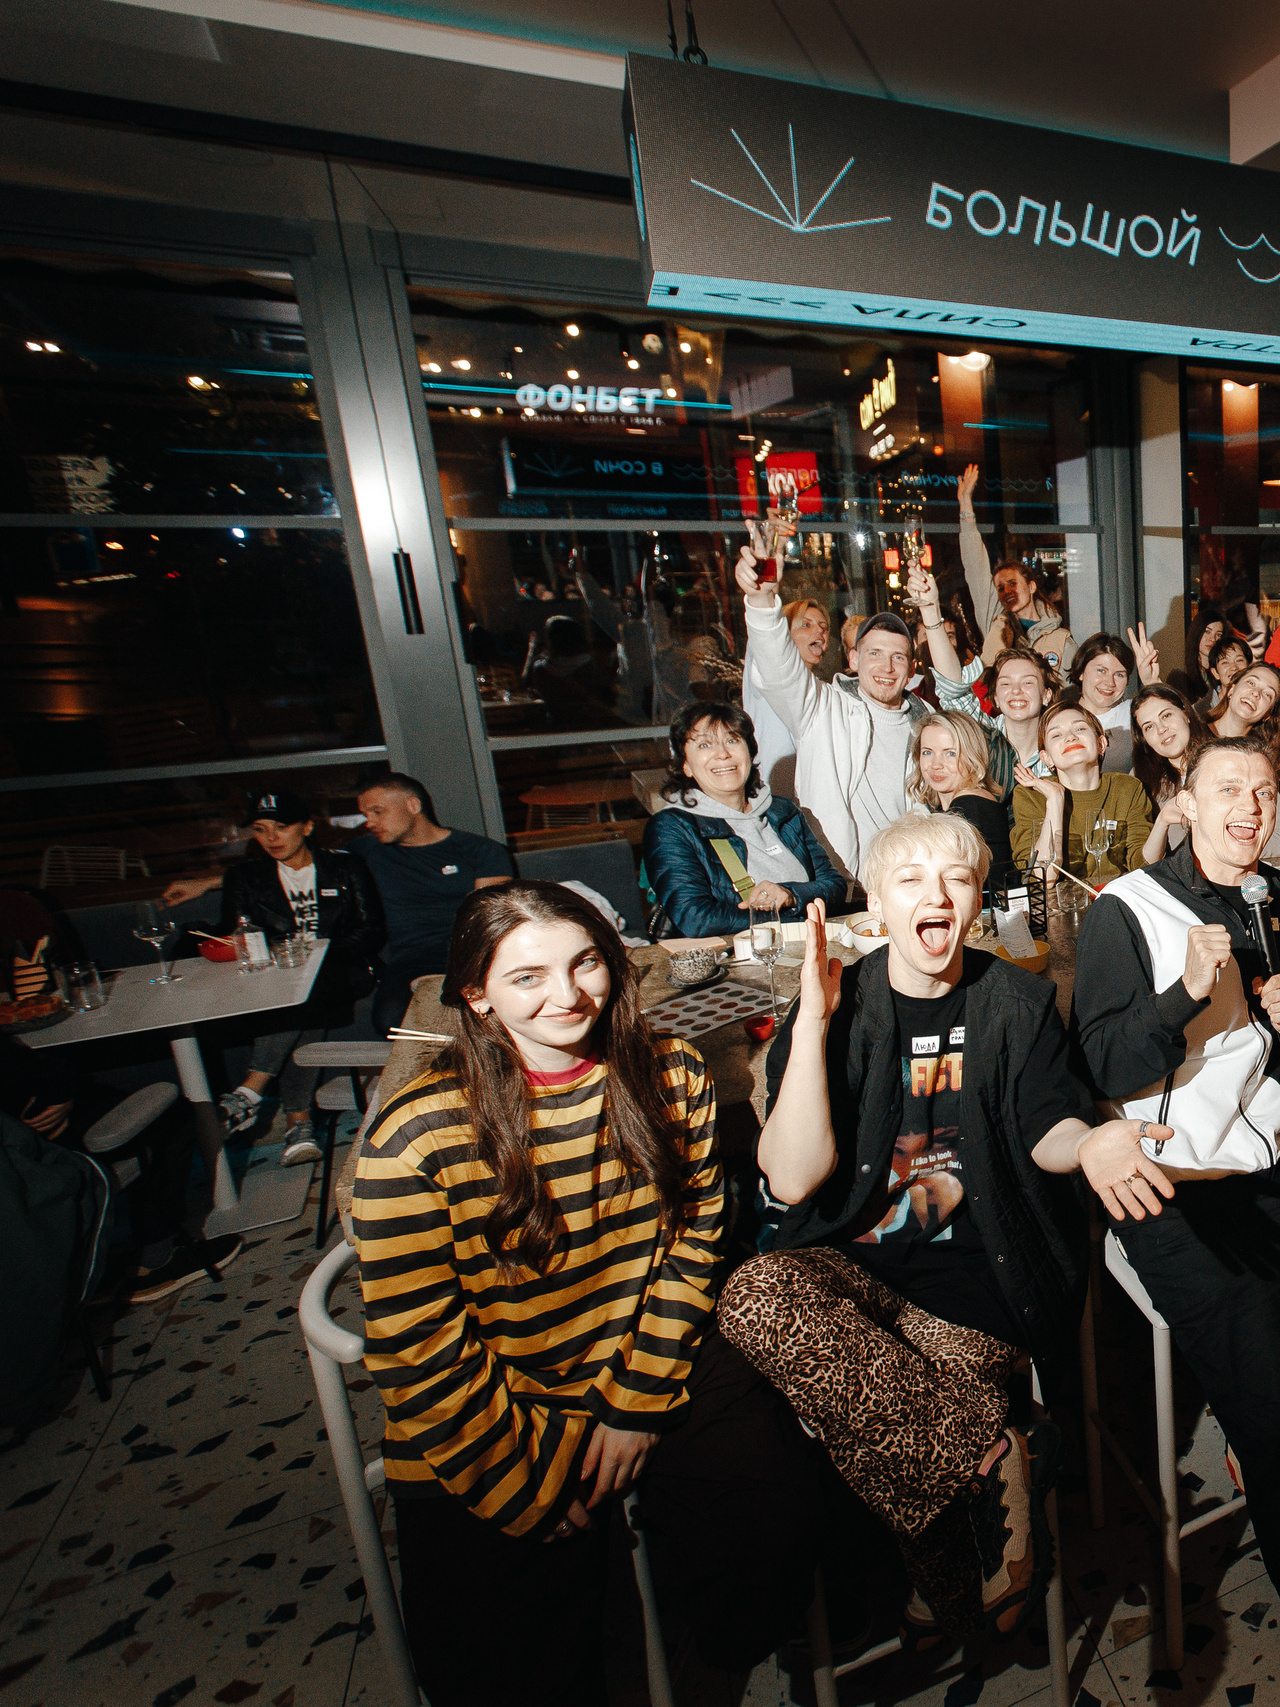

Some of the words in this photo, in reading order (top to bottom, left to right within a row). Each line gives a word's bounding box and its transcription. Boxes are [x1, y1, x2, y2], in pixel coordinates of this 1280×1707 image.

[925, 177, 1202, 267] БОЛЬШОЙ
[851, 303, 1027, 329] СИЛА
[515, 383, 664, 414] ФОНБЕТ
[928, 1154, 937, 1163] to
[936, 1150, 953, 1161] look
